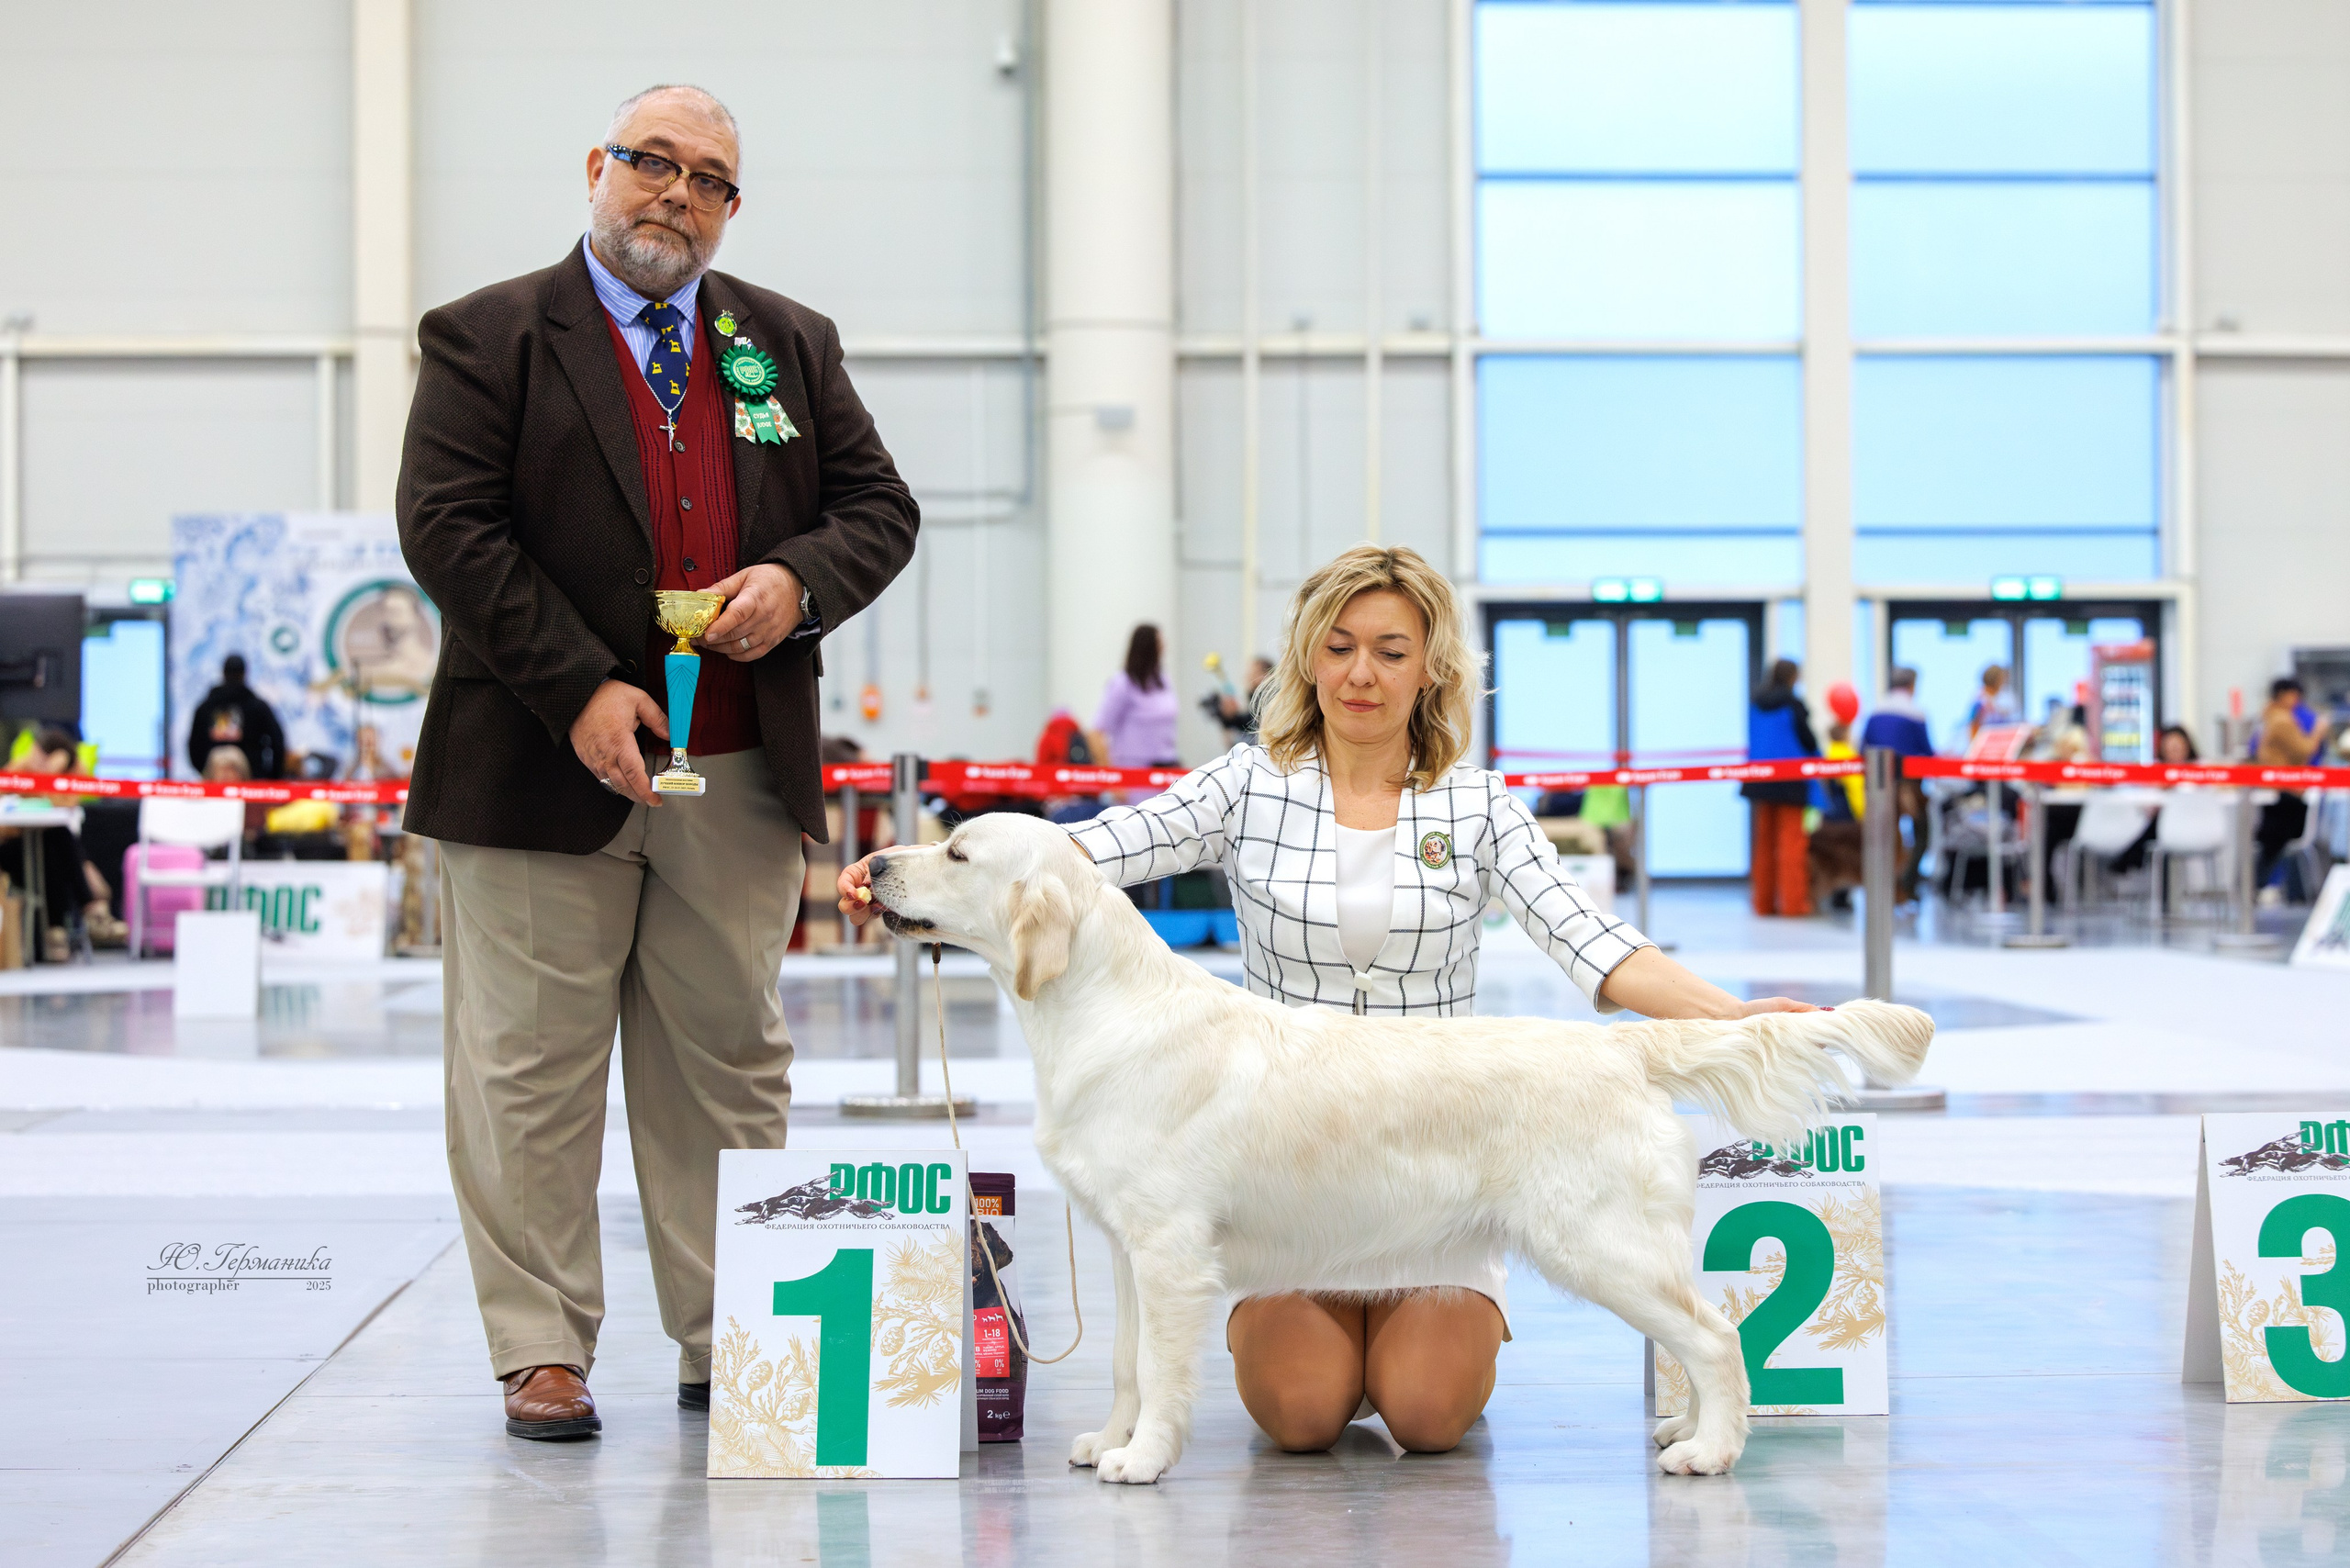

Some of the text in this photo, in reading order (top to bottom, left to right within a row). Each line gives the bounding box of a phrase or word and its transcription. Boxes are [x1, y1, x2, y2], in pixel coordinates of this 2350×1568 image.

[830, 1162, 952, 1215] РФОС
[975, 1198, 999, 1208] 100%
[764, 1223, 815, 1231] ФЕДЕРАЦИЯ
[878, 1223, 951, 1231] СОБАКОВОДСТВА
[1703, 1201, 1845, 1406] 2
[2258, 1193, 2350, 1398] 3
[983, 1328, 1002, 1338] 1-18
[773, 1249, 874, 1466] 1
[987, 1409, 993, 1418] 2
